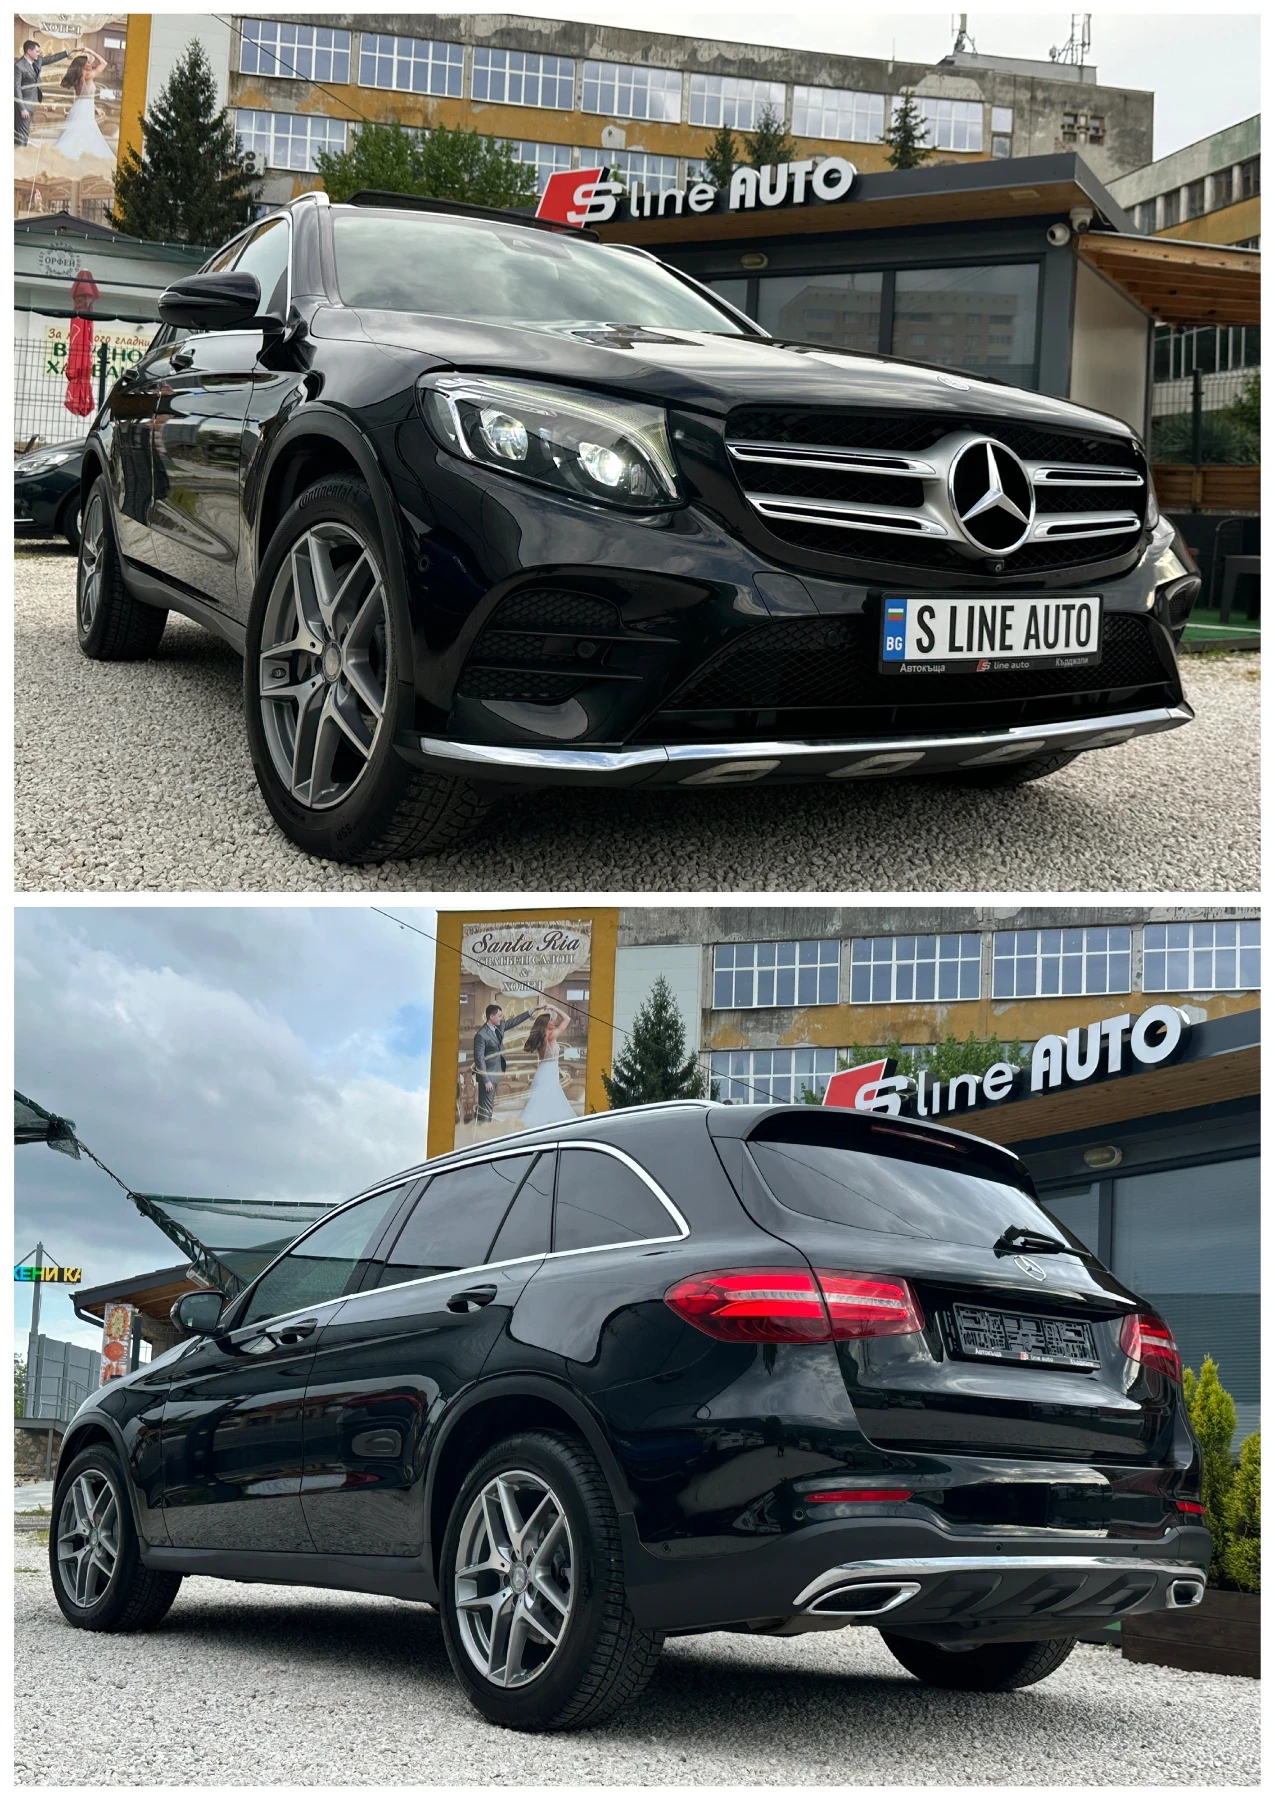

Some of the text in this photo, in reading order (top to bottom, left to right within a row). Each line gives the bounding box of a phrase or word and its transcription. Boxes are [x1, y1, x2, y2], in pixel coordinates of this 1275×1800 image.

[630, 181, 716, 217] line
[729, 156, 857, 210] AUTO
[48, 328, 61, 338] За
[115, 335, 150, 347] гладни
[299, 484, 353, 509] Continental
[916, 603, 1092, 653] S LINE AUTO
[886, 636, 903, 651] BG
[900, 663, 946, 673] Автокъща
[994, 661, 1009, 670] line
[1011, 661, 1030, 669] auto
[472, 930, 580, 953] Santa Ria
[519, 968, 530, 977] &
[917, 1062, 1014, 1117] line
[1031, 1004, 1186, 1092] AUTO
